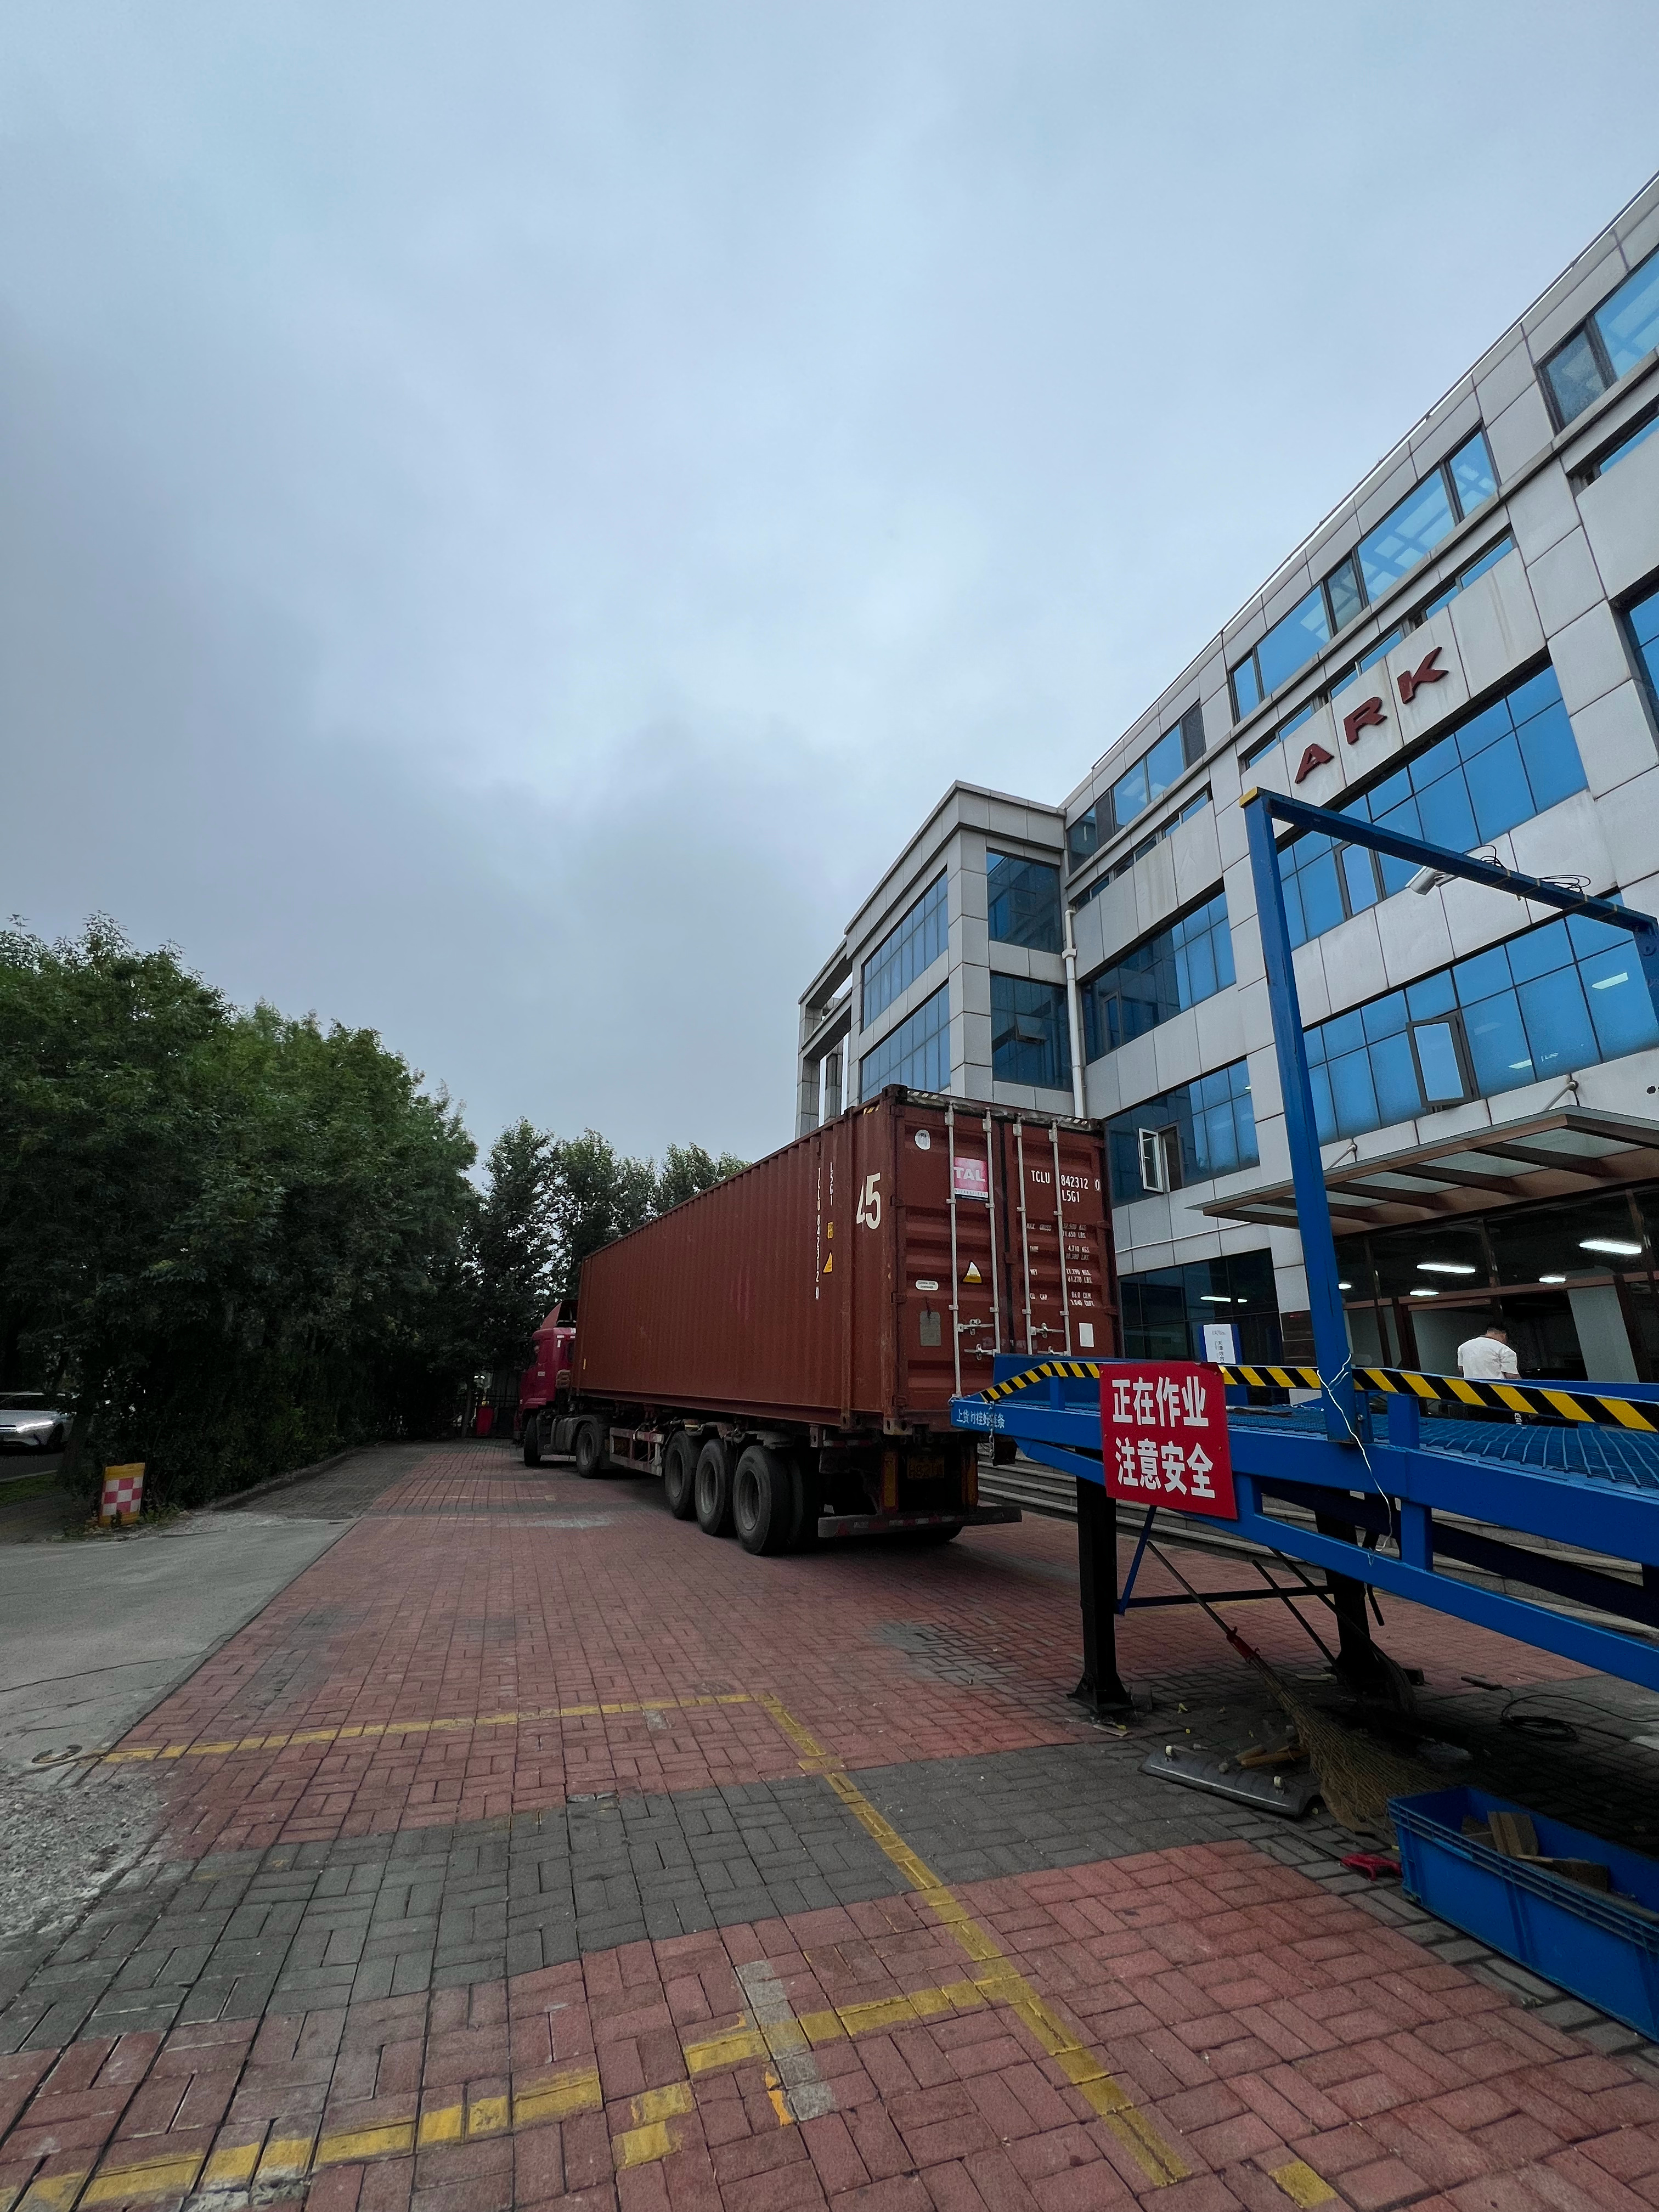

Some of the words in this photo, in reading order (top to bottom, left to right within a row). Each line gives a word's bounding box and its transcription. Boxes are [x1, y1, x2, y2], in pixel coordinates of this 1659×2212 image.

[1294, 646, 1449, 784] ARK
[953, 1166, 985, 1182] TAL
[1031, 1170, 1050, 1184] TCLU
[1060, 1175, 1088, 1189] 842312
[1094, 1179, 1101, 1191] 0
[1062, 1189, 1080, 1203] L5G1
[856, 1172, 881, 1229] 45
[1111, 1376, 1209, 1427] 正在作业
[1115, 1437, 1216, 1498] 注意安全
